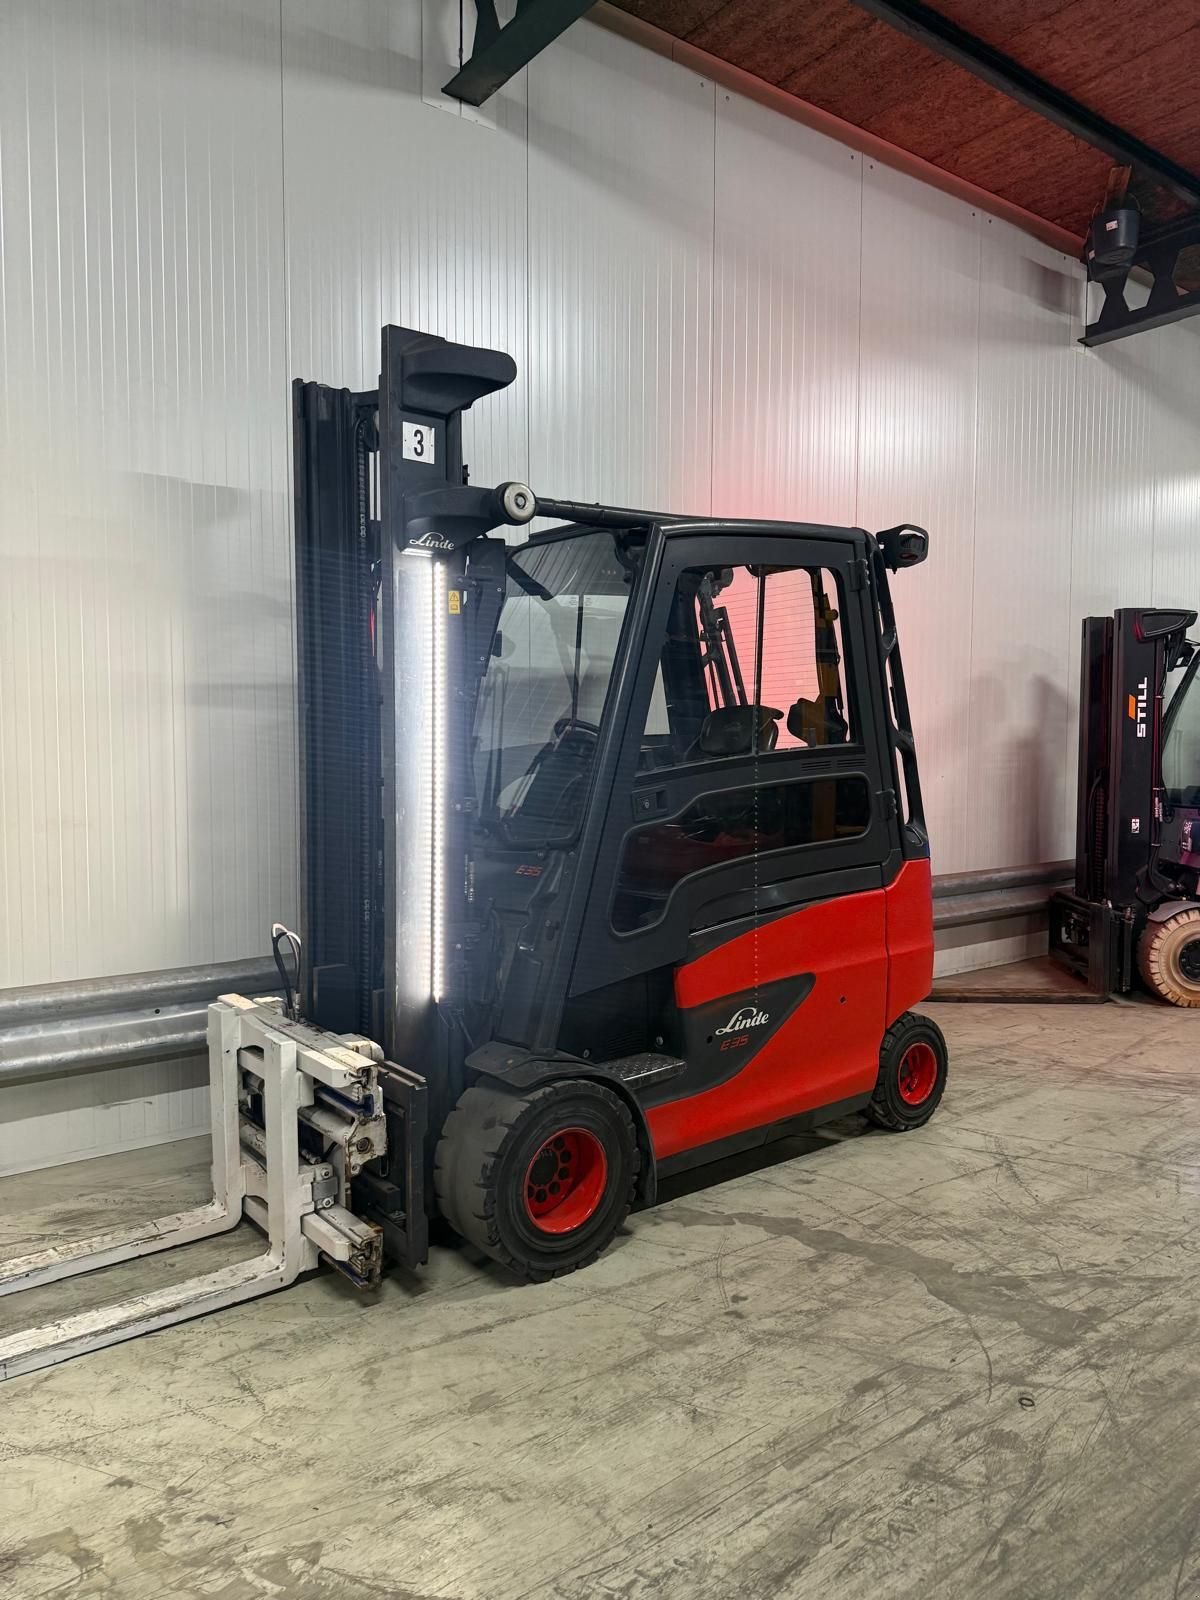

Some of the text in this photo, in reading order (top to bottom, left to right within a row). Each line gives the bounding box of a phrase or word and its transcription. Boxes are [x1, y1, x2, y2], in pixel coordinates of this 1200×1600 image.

[413, 429, 424, 457] 3
[409, 532, 454, 550] Linde
[1136, 677, 1148, 738] STILL
[515, 864, 544, 877] E35
[715, 1007, 769, 1036] Linde
[719, 1034, 749, 1051] E35
